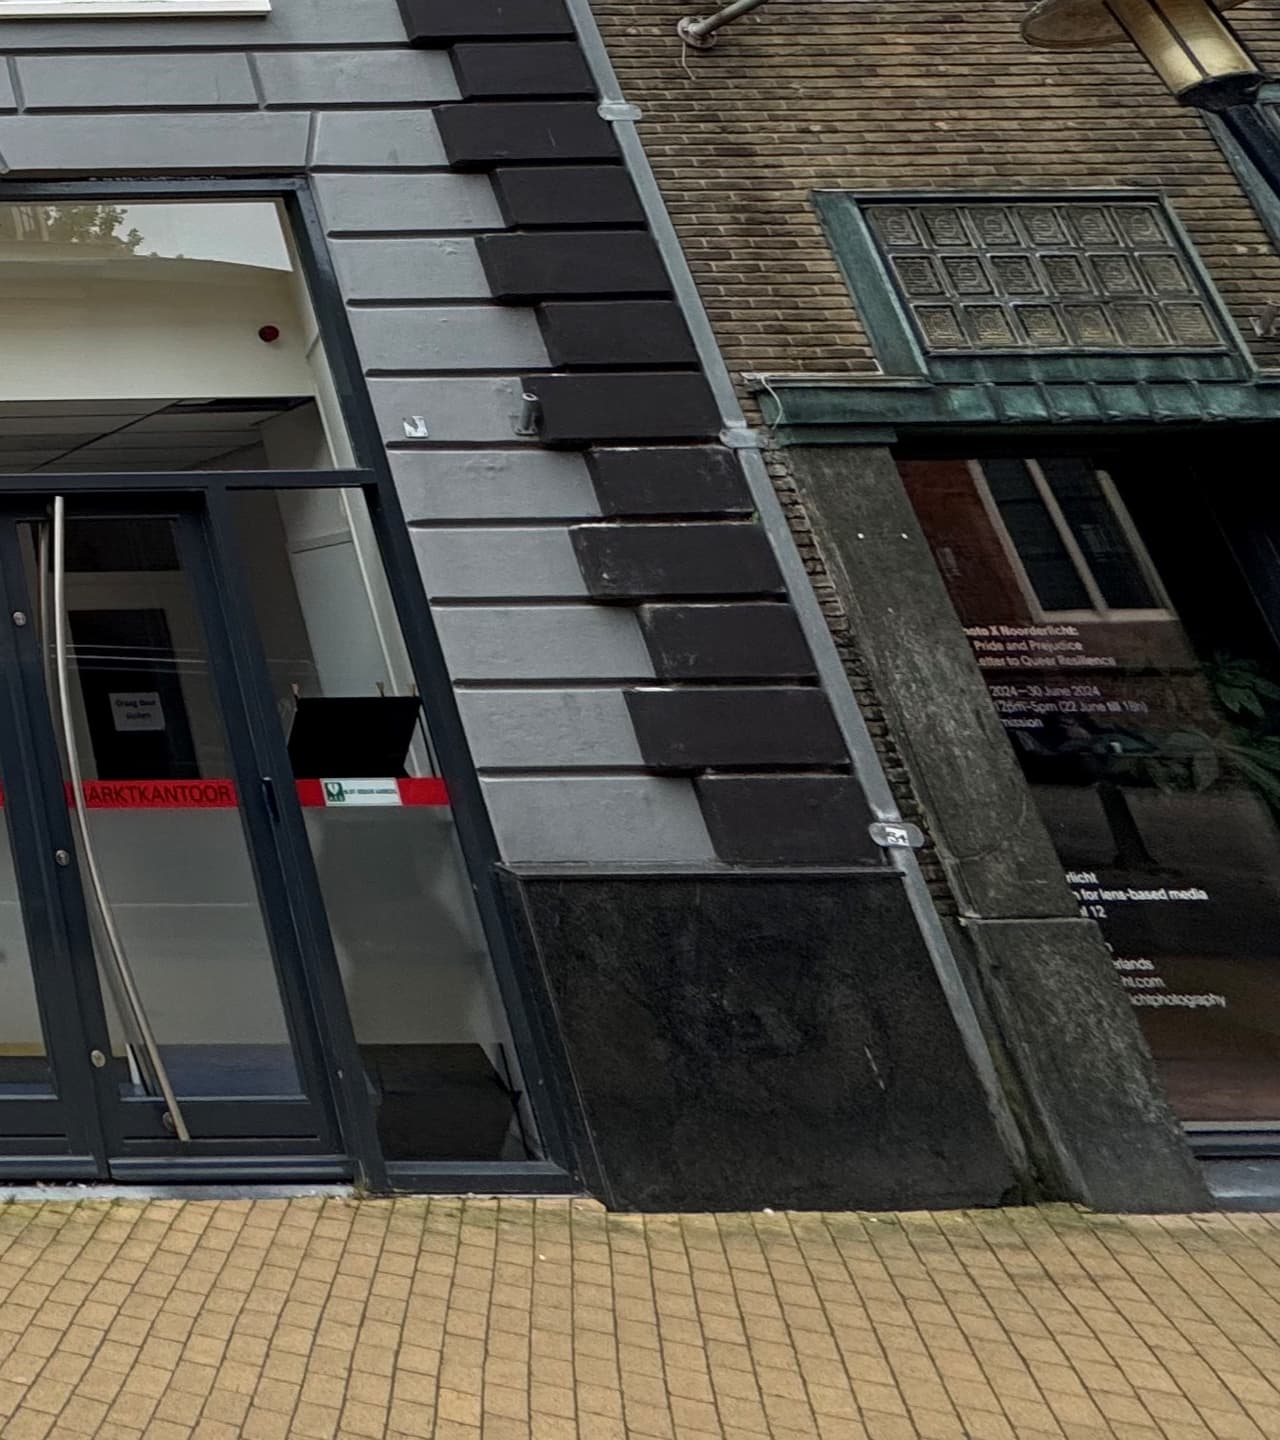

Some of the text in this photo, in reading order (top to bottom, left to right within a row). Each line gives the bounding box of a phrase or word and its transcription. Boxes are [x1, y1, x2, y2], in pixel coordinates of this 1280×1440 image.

[973, 639, 1084, 654] Pride and Prejudice
[1044, 685, 1071, 697] June
[1071, 685, 1102, 697] 2024
[1080, 888, 1099, 900] for
[1099, 888, 1170, 901] lens-based
[1170, 888, 1209, 901] media
[1089, 905, 1108, 918] 12
